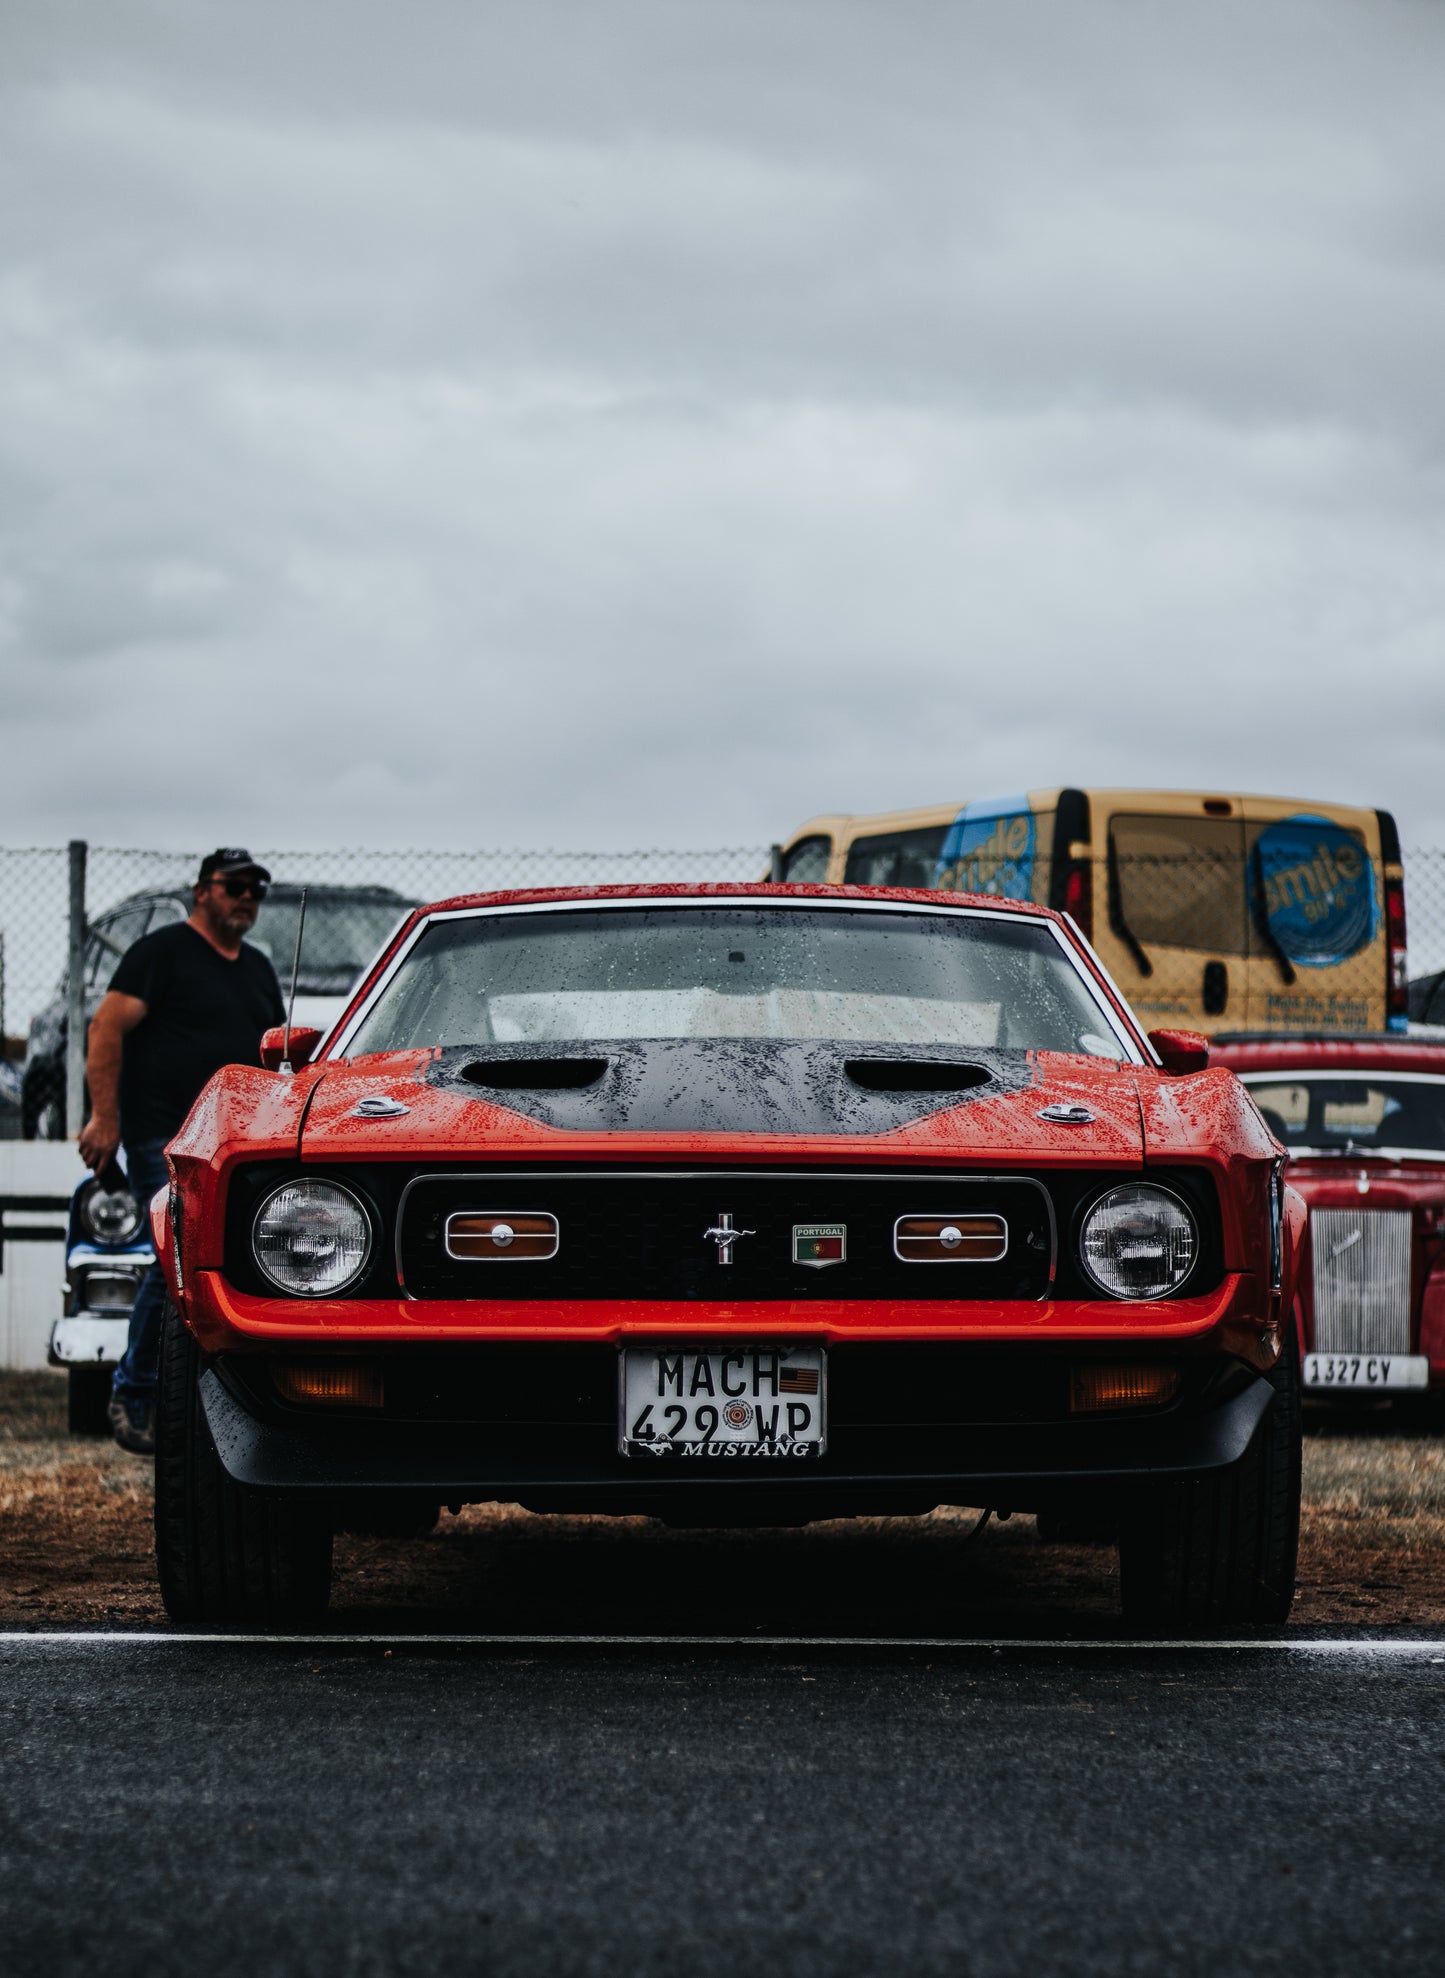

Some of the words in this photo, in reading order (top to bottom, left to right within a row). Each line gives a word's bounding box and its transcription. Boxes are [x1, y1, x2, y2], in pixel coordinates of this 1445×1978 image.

[797, 1228, 842, 1236] PORTUGAL
[658, 1355, 779, 1397] MACH
[632, 1404, 719, 1441] 429
[755, 1402, 811, 1441] WP
[681, 1442, 810, 1456] MUSTANG
